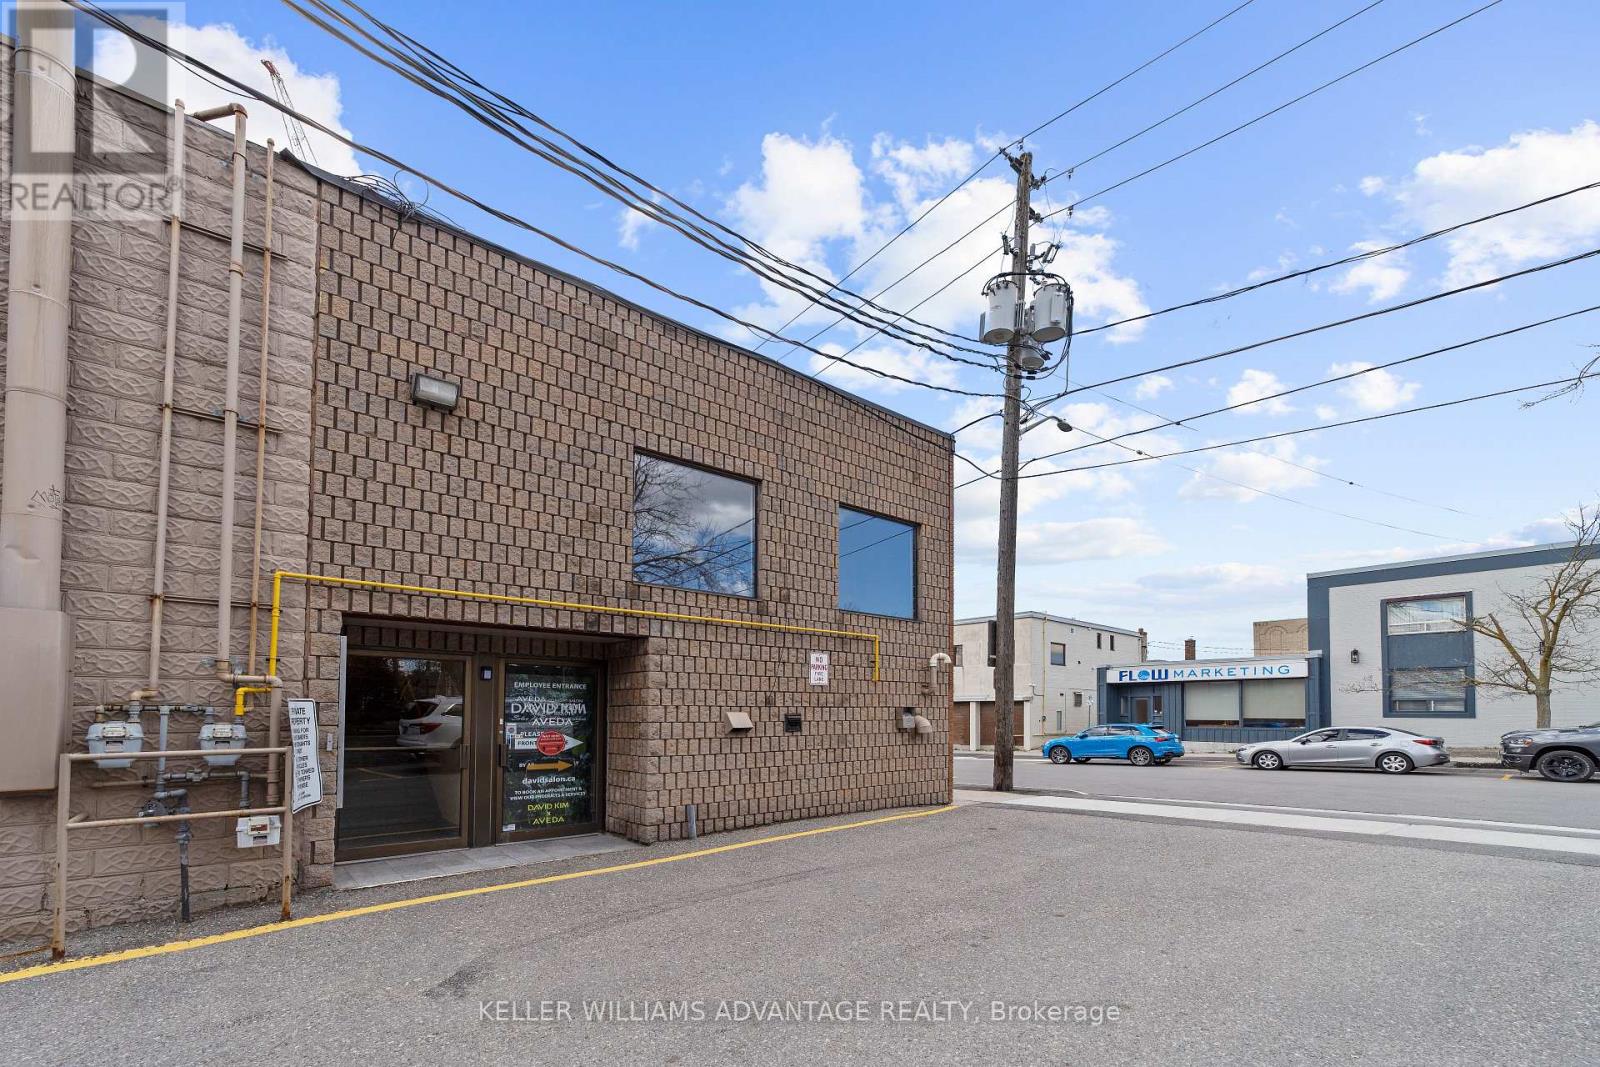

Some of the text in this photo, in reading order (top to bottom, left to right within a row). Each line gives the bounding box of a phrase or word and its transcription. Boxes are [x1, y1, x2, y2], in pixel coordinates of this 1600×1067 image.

[1118, 664, 1291, 681] FLOW MARKETING
[552, 682, 588, 690] ENTRANCE
[511, 703, 557, 714] DAVID
[532, 718, 574, 726] AVEDA
[522, 776, 575, 785] davidsalon.ca
[527, 803, 553, 812] DAVID
[532, 816, 565, 825] AVEDA
